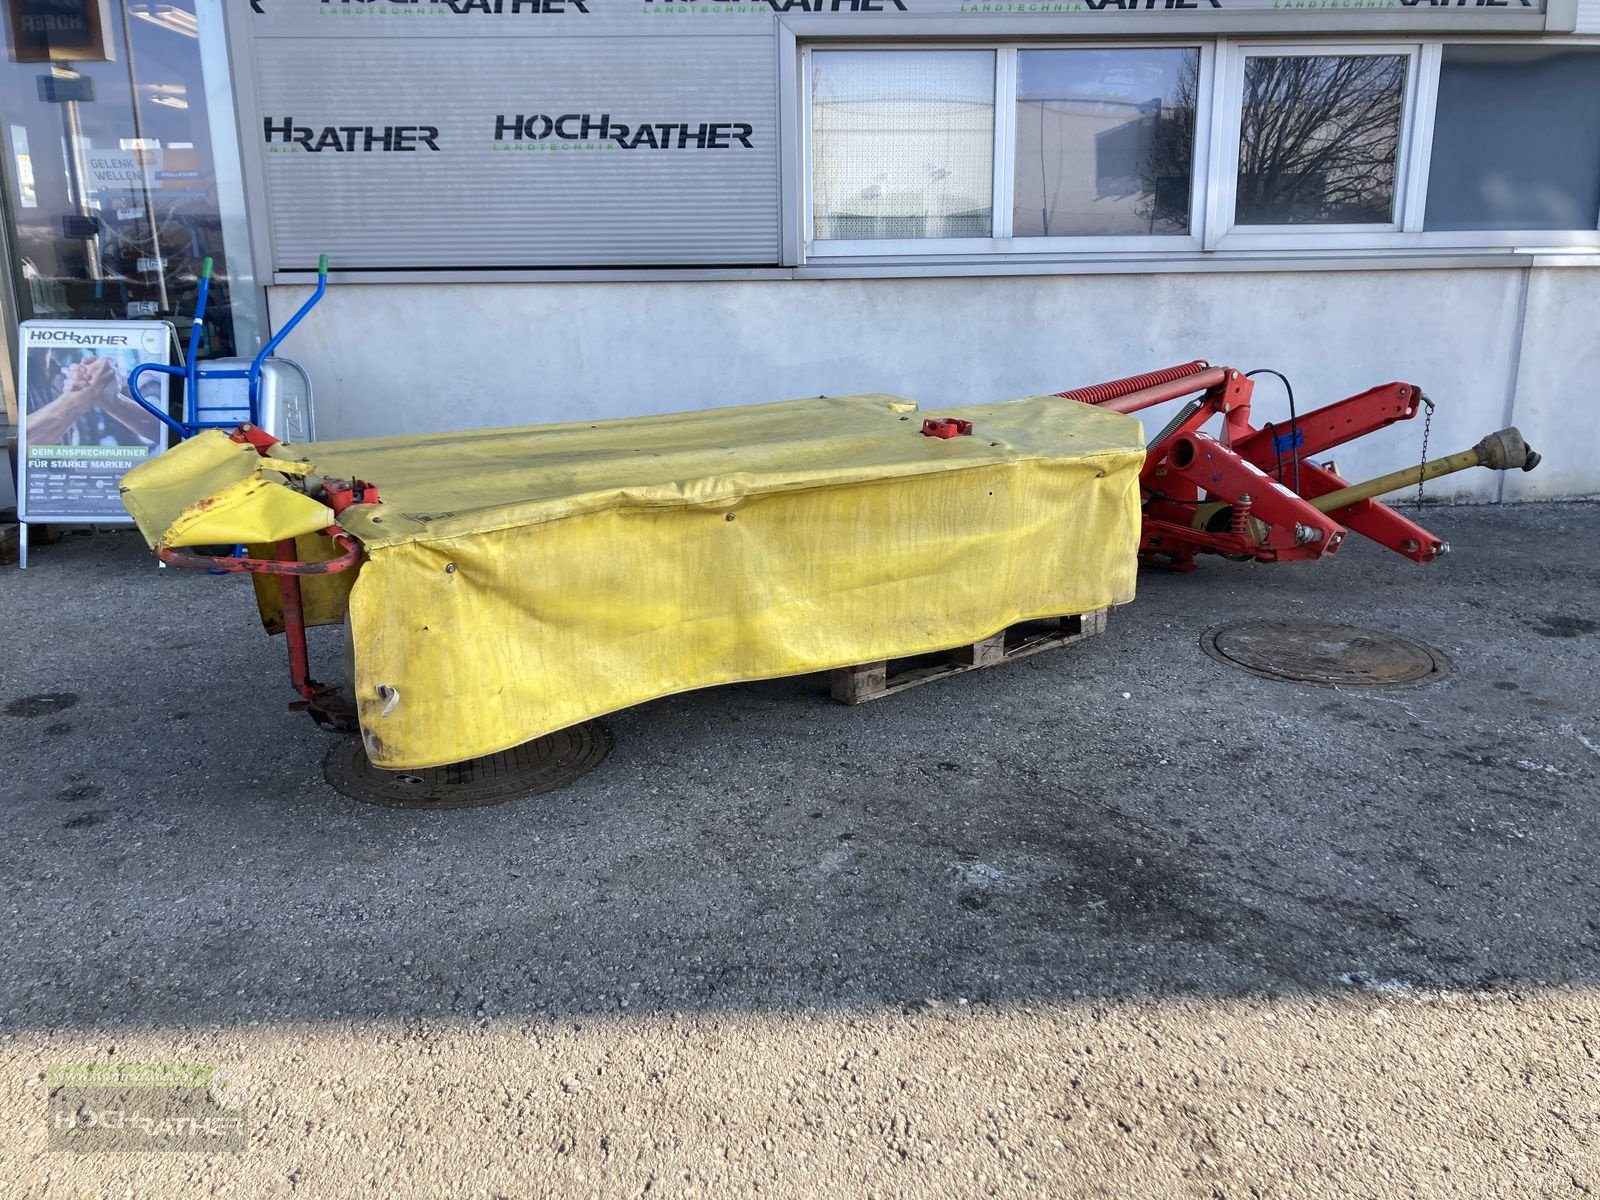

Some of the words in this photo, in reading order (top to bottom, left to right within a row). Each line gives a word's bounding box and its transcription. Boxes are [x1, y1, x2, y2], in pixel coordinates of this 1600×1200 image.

[319, 7, 447, 15] LANDTECHNIK
[643, 5, 767, 13] LANDTECHNIK
[960, 4, 1082, 12] LANDTECHNIK
[494, 114, 754, 149] HOCHRATHER
[492, 143, 615, 151] LANDTECHNIK
[90, 158, 135, 169] GELENK
[94, 170, 142, 181] WELLEN
[30, 330, 128, 346] HOCHRATHER
[31, 448, 54, 456] DEIN
[56, 448, 146, 457] ANSPRECHPARTNER
[28, 459, 48, 468] FÜR
[50, 460, 88, 469] STARKE
[90, 460, 132, 469] MARKEN
